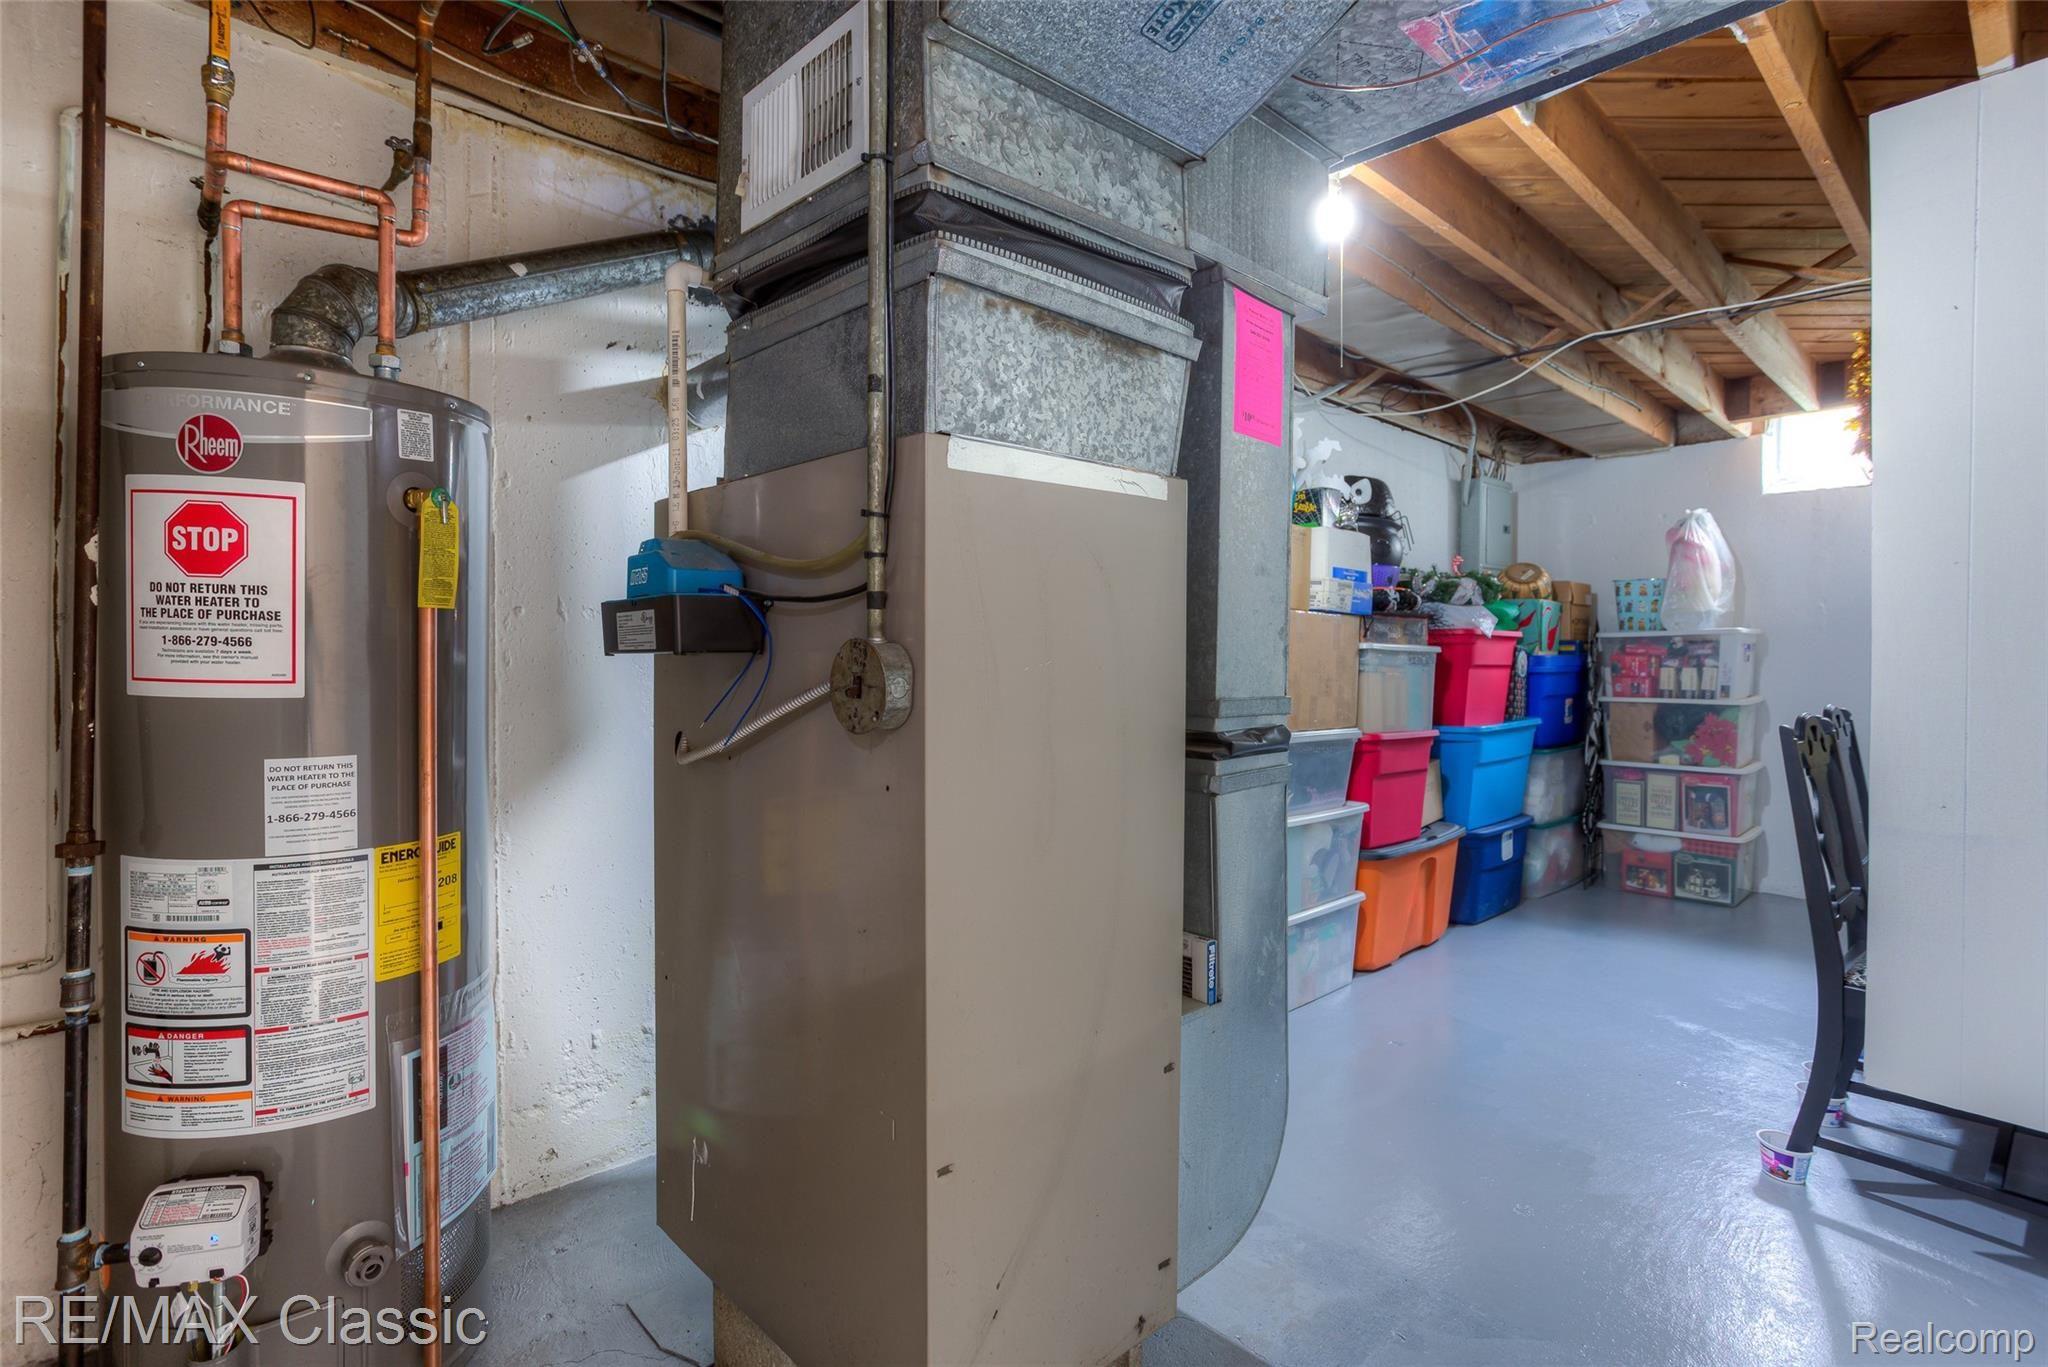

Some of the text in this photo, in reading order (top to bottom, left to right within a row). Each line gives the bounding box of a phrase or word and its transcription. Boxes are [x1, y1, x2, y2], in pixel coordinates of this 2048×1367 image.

[1146, 0, 1186, 37] KOTE
[184, 415, 238, 464] Rheem
[172, 525, 239, 552] STOP
[150, 582, 268, 596] DO NOT RETURN THIS
[155, 595, 260, 609] WATER HEATER TO
[140, 607, 281, 621] THE PLACE OF PURCHASE
[161, 635, 253, 647] 1-866-279-4566
[303, 763, 335, 772] RETURN
[296, 773, 327, 781] HEATER
[271, 784, 296, 792] PLACE
[310, 780, 351, 790] PURCHASE
[267, 808, 357, 824] 1-866-279-4566
[381, 838, 456, 865] ENERGUIDE
